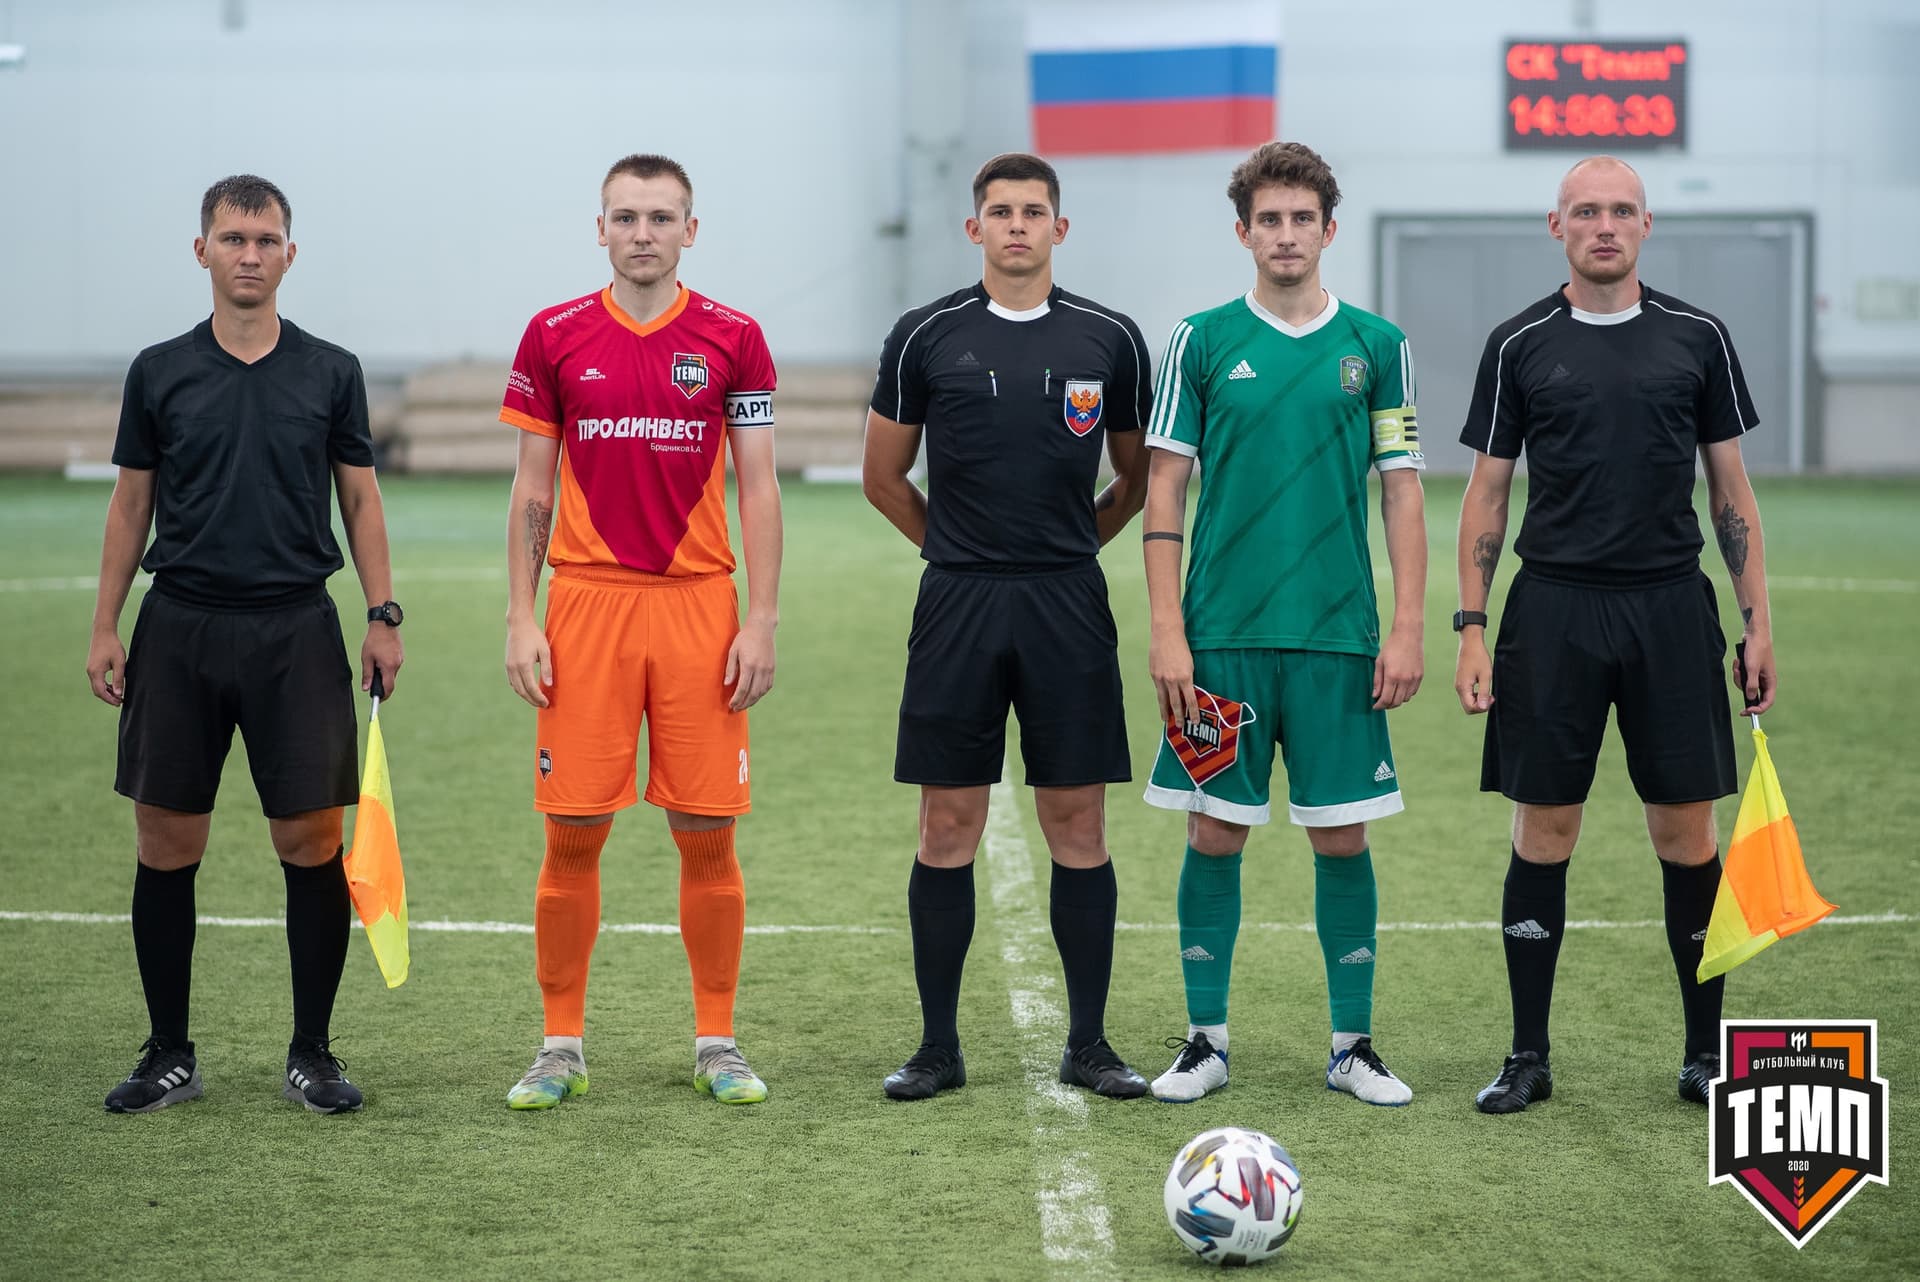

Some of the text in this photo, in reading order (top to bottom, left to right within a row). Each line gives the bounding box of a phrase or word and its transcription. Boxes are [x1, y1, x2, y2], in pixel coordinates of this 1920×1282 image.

[675, 365, 705, 384] ТЕМП
[1228, 371, 1257, 380] adidas
[577, 416, 707, 442] ПРОДИНВЕСТ
[1186, 719, 1218, 745] ТЕМП
[1503, 926, 1550, 939] adidas
